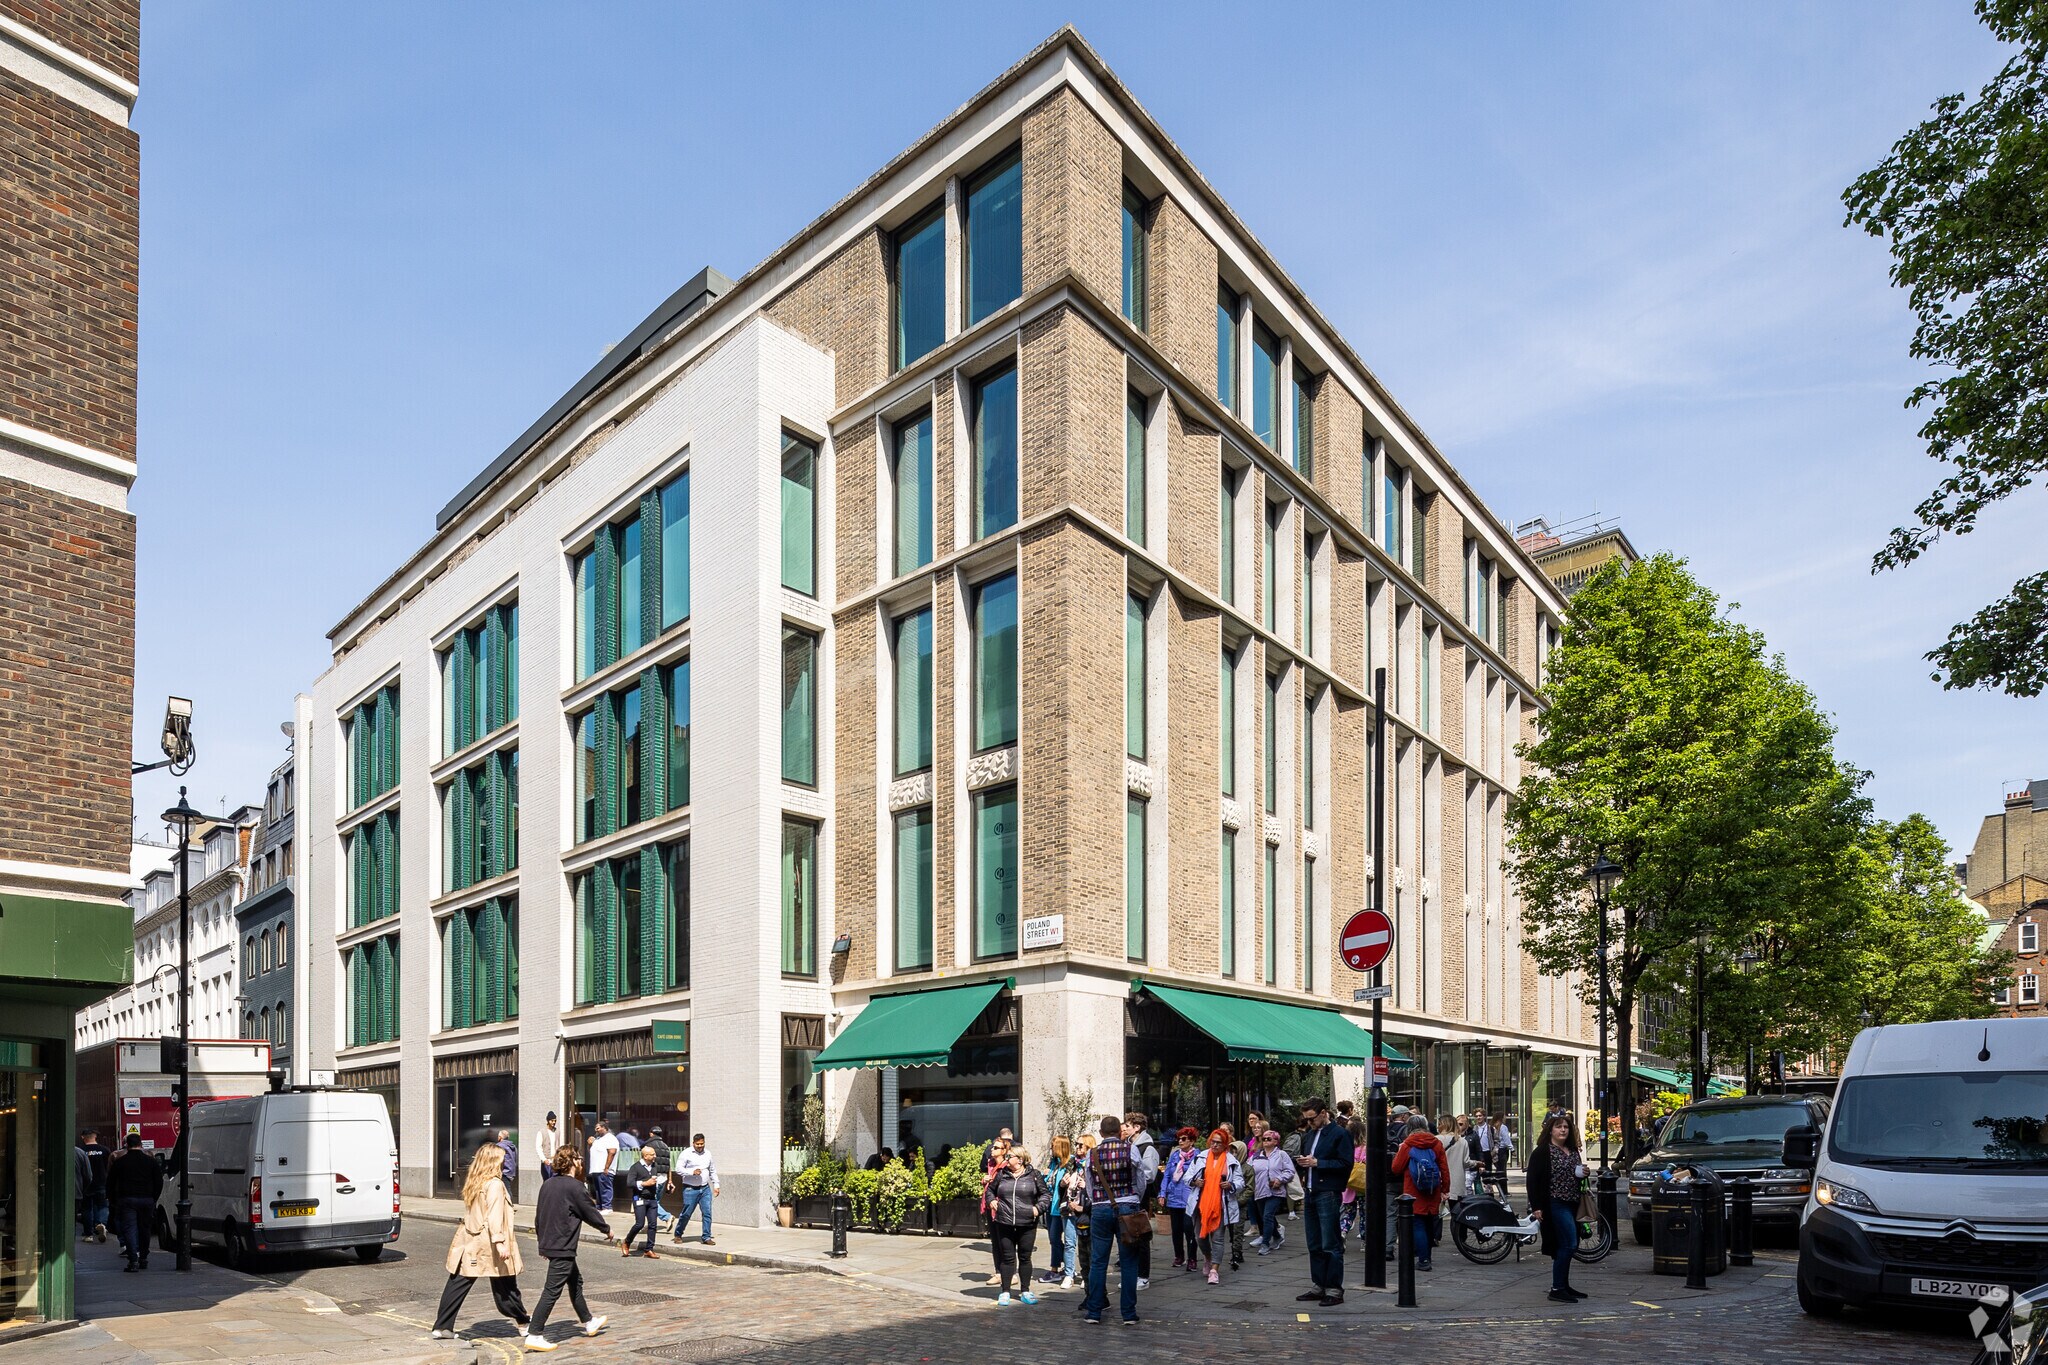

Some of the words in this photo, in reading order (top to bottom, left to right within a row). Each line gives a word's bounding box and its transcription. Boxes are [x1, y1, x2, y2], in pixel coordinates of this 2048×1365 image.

[1026, 919, 1051, 930] POLAND
[1026, 928, 1049, 939] STREET
[1049, 927, 1059, 935] W1
[1918, 1280, 1962, 1294] LB22
[1967, 1284, 2001, 1298] YOG
